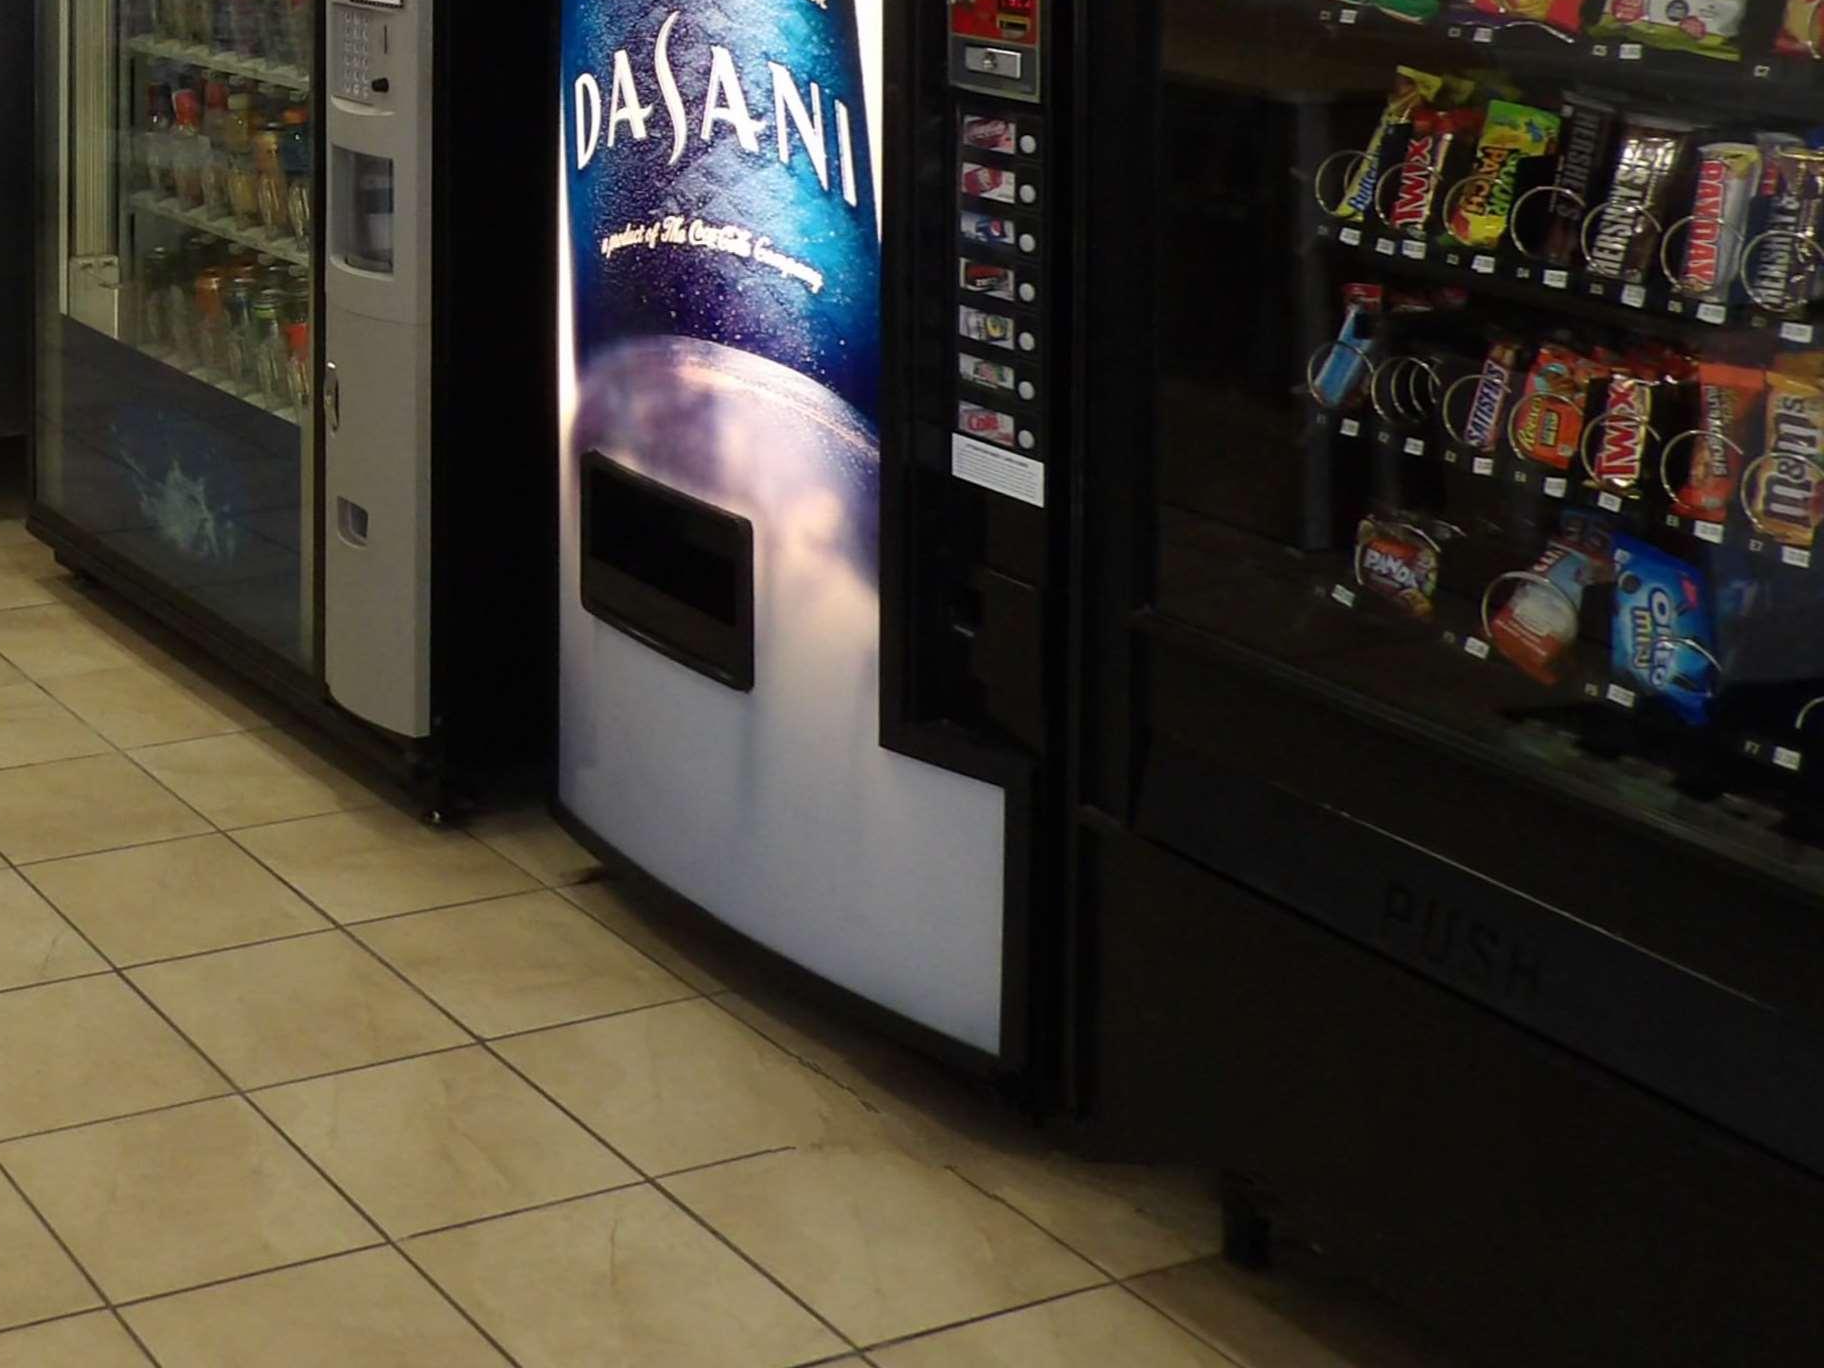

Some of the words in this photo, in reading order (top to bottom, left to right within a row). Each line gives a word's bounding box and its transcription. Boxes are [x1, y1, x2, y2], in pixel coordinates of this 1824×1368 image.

[575, 10, 857, 207] DASANI
[1391, 135, 1434, 229] TWIX
[1461, 144, 1512, 216] PATCH
[1684, 160, 1725, 284] PAYDAY
[645, 222, 660, 249] of
[1596, 381, 1636, 480] TWIX
[1384, 882, 1539, 998] PUSH
